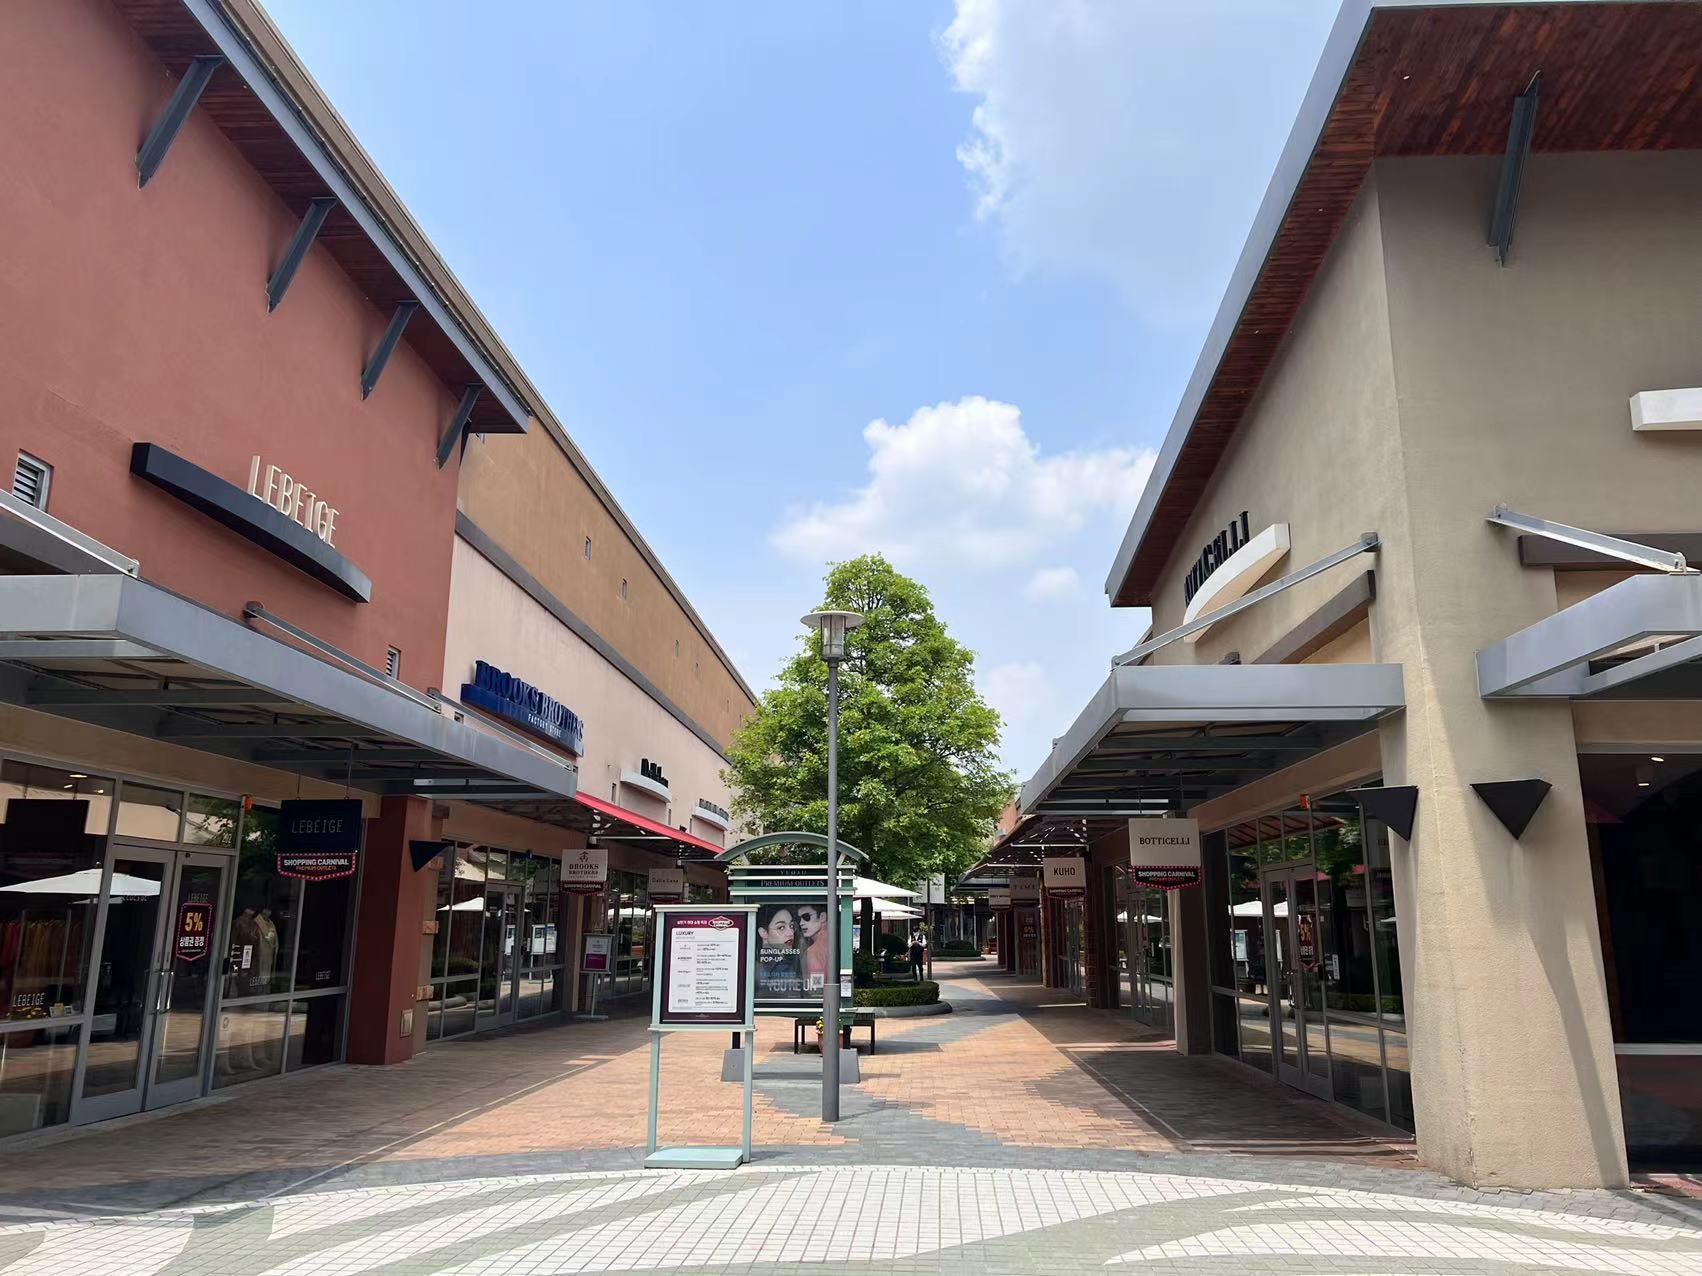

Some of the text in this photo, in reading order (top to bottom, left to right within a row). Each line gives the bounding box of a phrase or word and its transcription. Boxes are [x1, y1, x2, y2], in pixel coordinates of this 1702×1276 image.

[247, 455, 340, 549] LEBEIGE
[291, 819, 343, 834] LEBEIGE
[1139, 837, 1190, 845] BOTTICELLI
[318, 858, 349, 866] CARNIVAL
[1053, 867, 1076, 876] KUHO
[184, 912, 203, 932] 5%
[12, 992, 45, 1007] LEBEIGE
